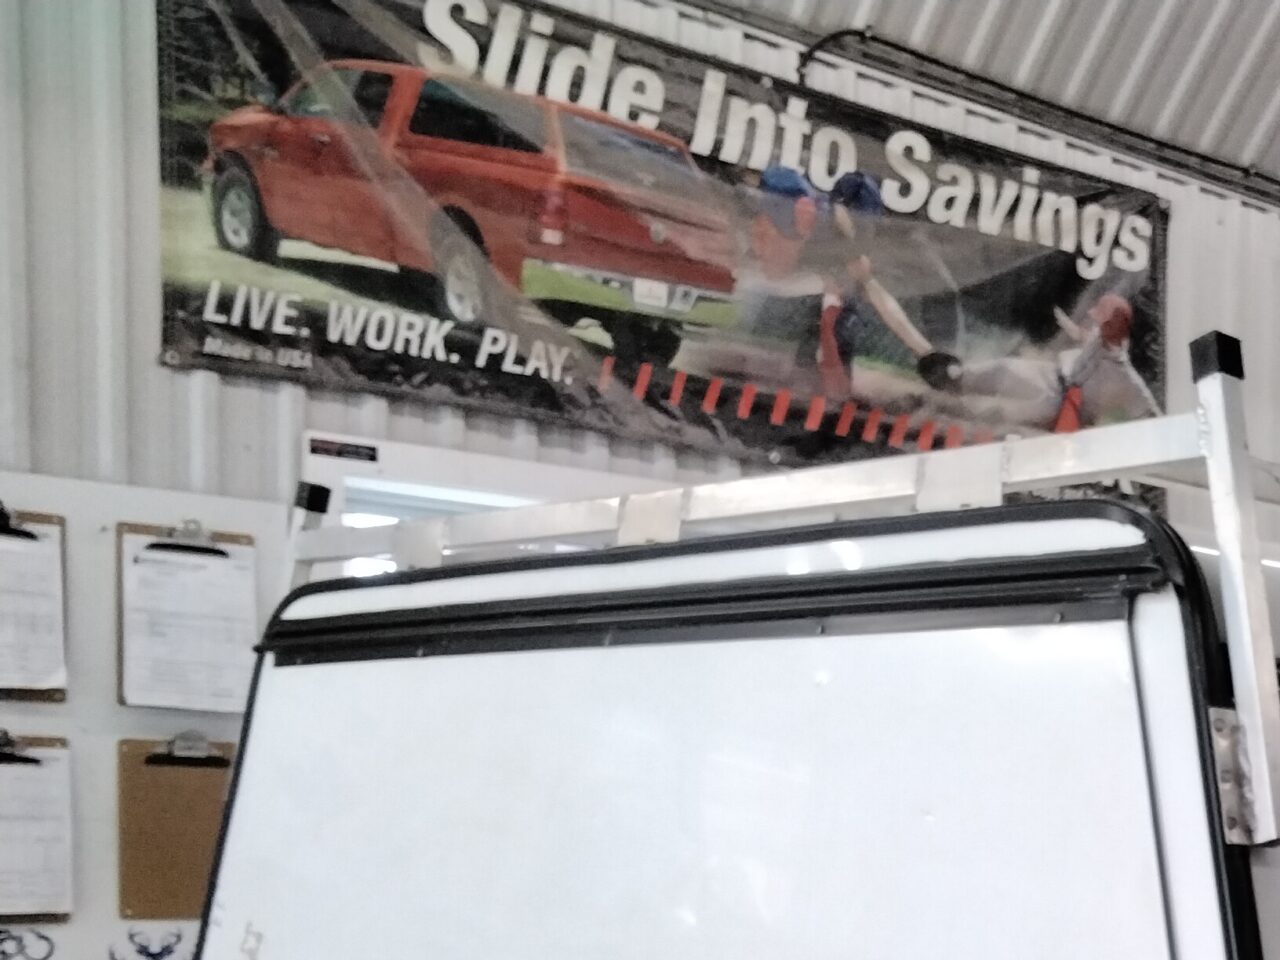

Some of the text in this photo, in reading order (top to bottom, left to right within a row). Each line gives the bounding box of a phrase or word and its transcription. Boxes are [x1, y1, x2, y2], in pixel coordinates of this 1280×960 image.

[416, 0, 1153, 279] Slide Into Savings
[203, 280, 575, 386] LIVE. WORK. PLAY.
